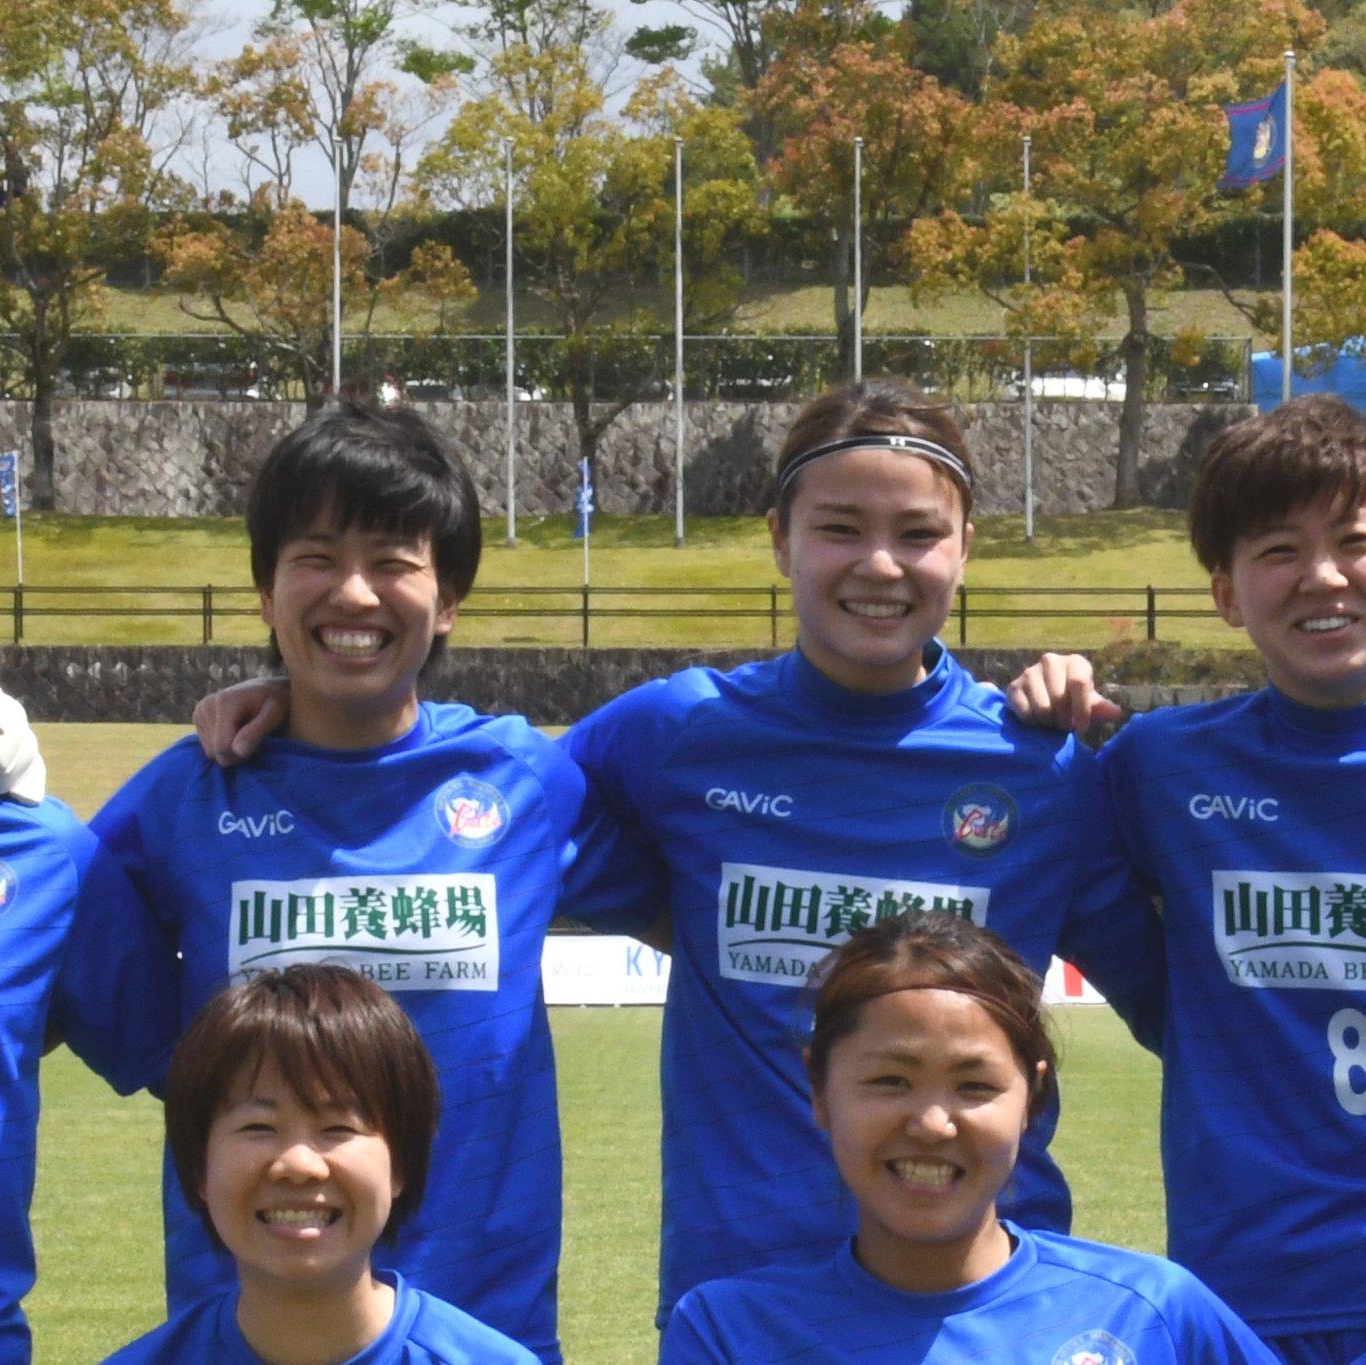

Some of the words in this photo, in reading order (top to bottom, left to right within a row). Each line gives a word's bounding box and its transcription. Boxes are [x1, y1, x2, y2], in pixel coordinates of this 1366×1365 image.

[238, 884, 488, 946] 山田養蜂場
[360, 961, 411, 982] BEE
[424, 960, 488, 981] FARM
[1229, 959, 1329, 980] YAMADA
